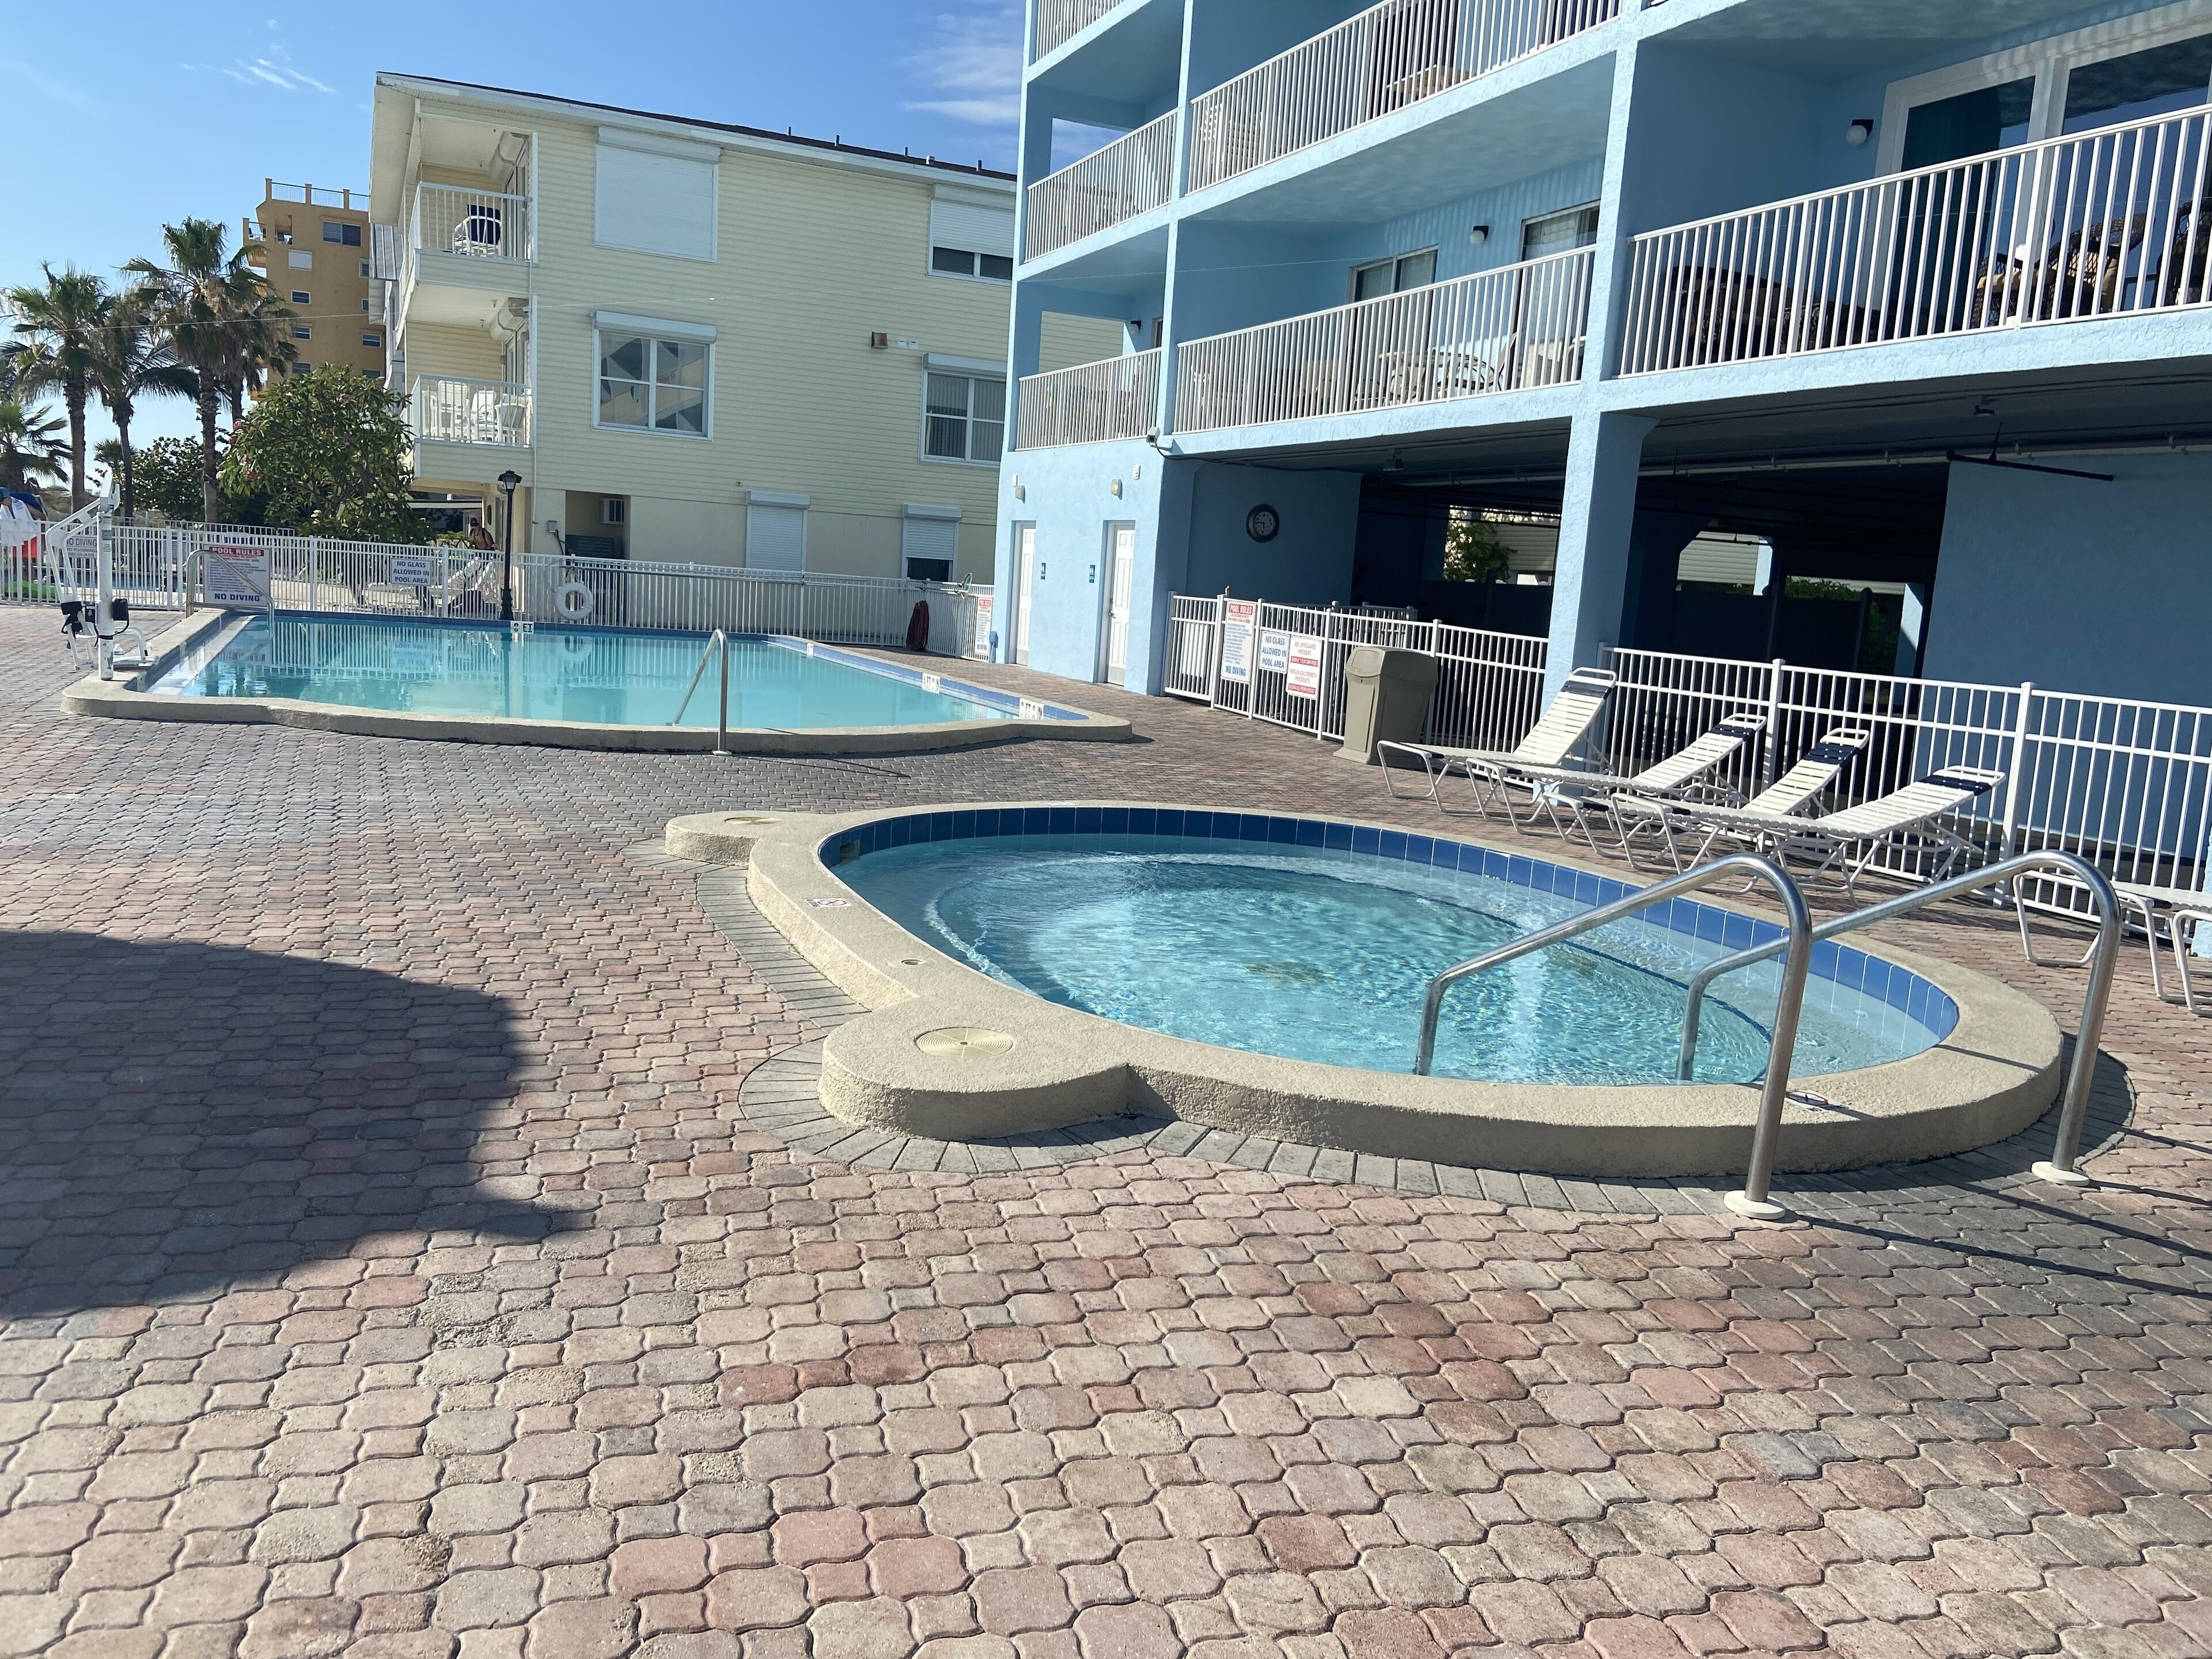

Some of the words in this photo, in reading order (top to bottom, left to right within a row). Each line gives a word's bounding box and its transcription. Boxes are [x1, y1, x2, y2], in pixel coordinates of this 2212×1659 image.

[1272, 637, 1285, 645] GLASS
[1262, 647, 1281, 656] ALLOWED
[1262, 658, 1272, 666] POOL
[1274, 660, 1285, 668] AREA
[1226, 665, 1231, 673] NO
[1232, 666, 1246, 676] DIVING
